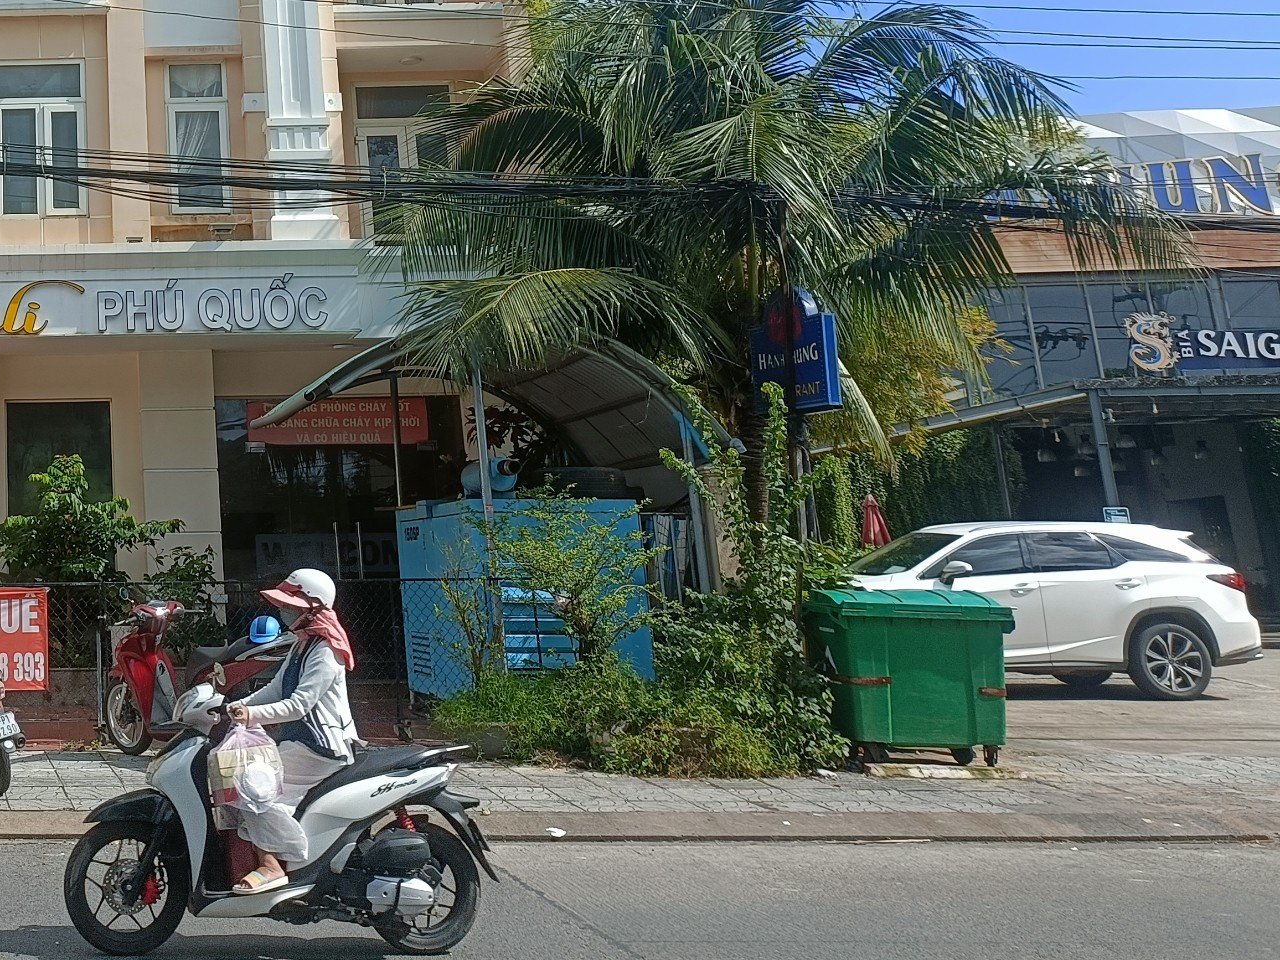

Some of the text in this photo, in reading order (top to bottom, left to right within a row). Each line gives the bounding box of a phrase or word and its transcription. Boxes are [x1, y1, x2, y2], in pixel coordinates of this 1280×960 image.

[97, 278, 185, 332] PHÚ
[198, 272, 330, 331] QUỐC
[1177, 329, 1194, 358] BIA
[320, 401, 356, 413] PHÒNG
[358, 401, 387, 413] CHÁY
[389, 398, 410, 412] ỐT
[310, 415, 340, 428] CHỮA
[342, 415, 371, 427] CHÁY
[374, 417, 392, 429] KỊP
[296, 431, 311, 443] VÀ
[313, 431, 328, 443] CÓ
[359, 429, 381, 443] QUẢ
[13, 652, 45, 682] 393
